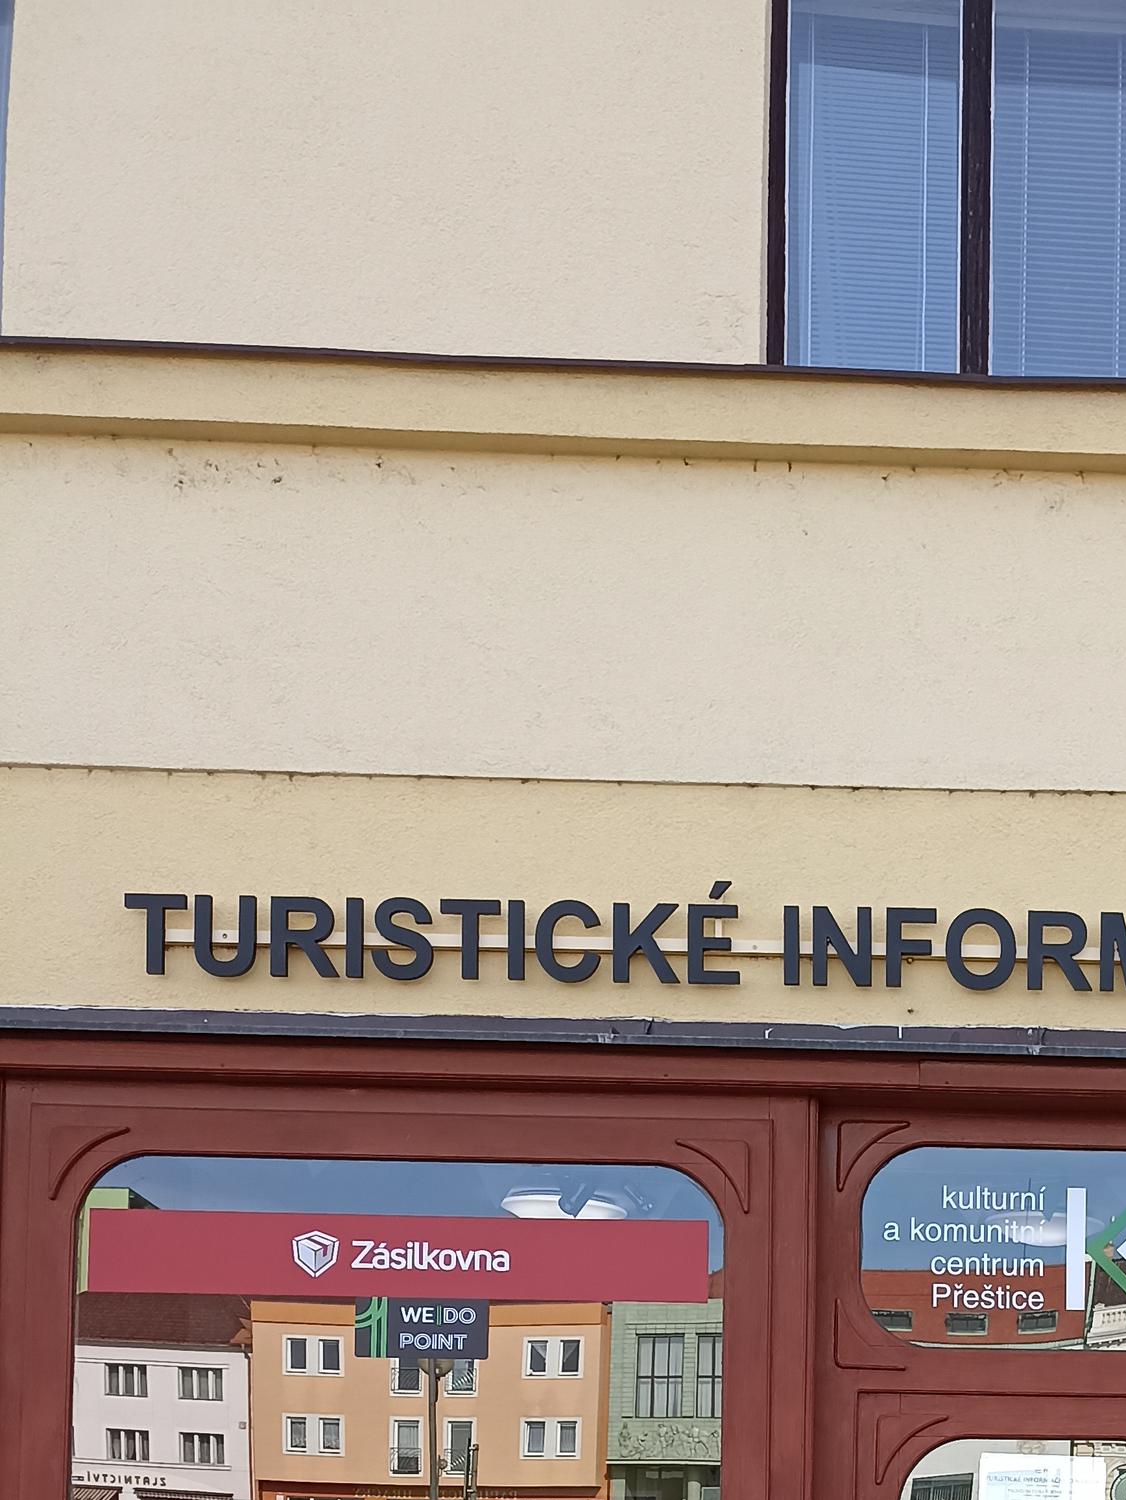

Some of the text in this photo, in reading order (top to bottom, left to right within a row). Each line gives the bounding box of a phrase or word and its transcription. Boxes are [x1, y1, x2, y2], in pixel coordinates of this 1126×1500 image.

[124, 880, 742, 986] TURISTICKÉ
[942, 1185, 1046, 1211] kulturní
[883, 1217, 1046, 1243] a komunitní
[351, 1240, 511, 1272] Zásilkovna
[930, 1253, 1045, 1277] centrum
[931, 1282, 1045, 1310] Přeštice
[400, 1333, 468, 1351] POINT
